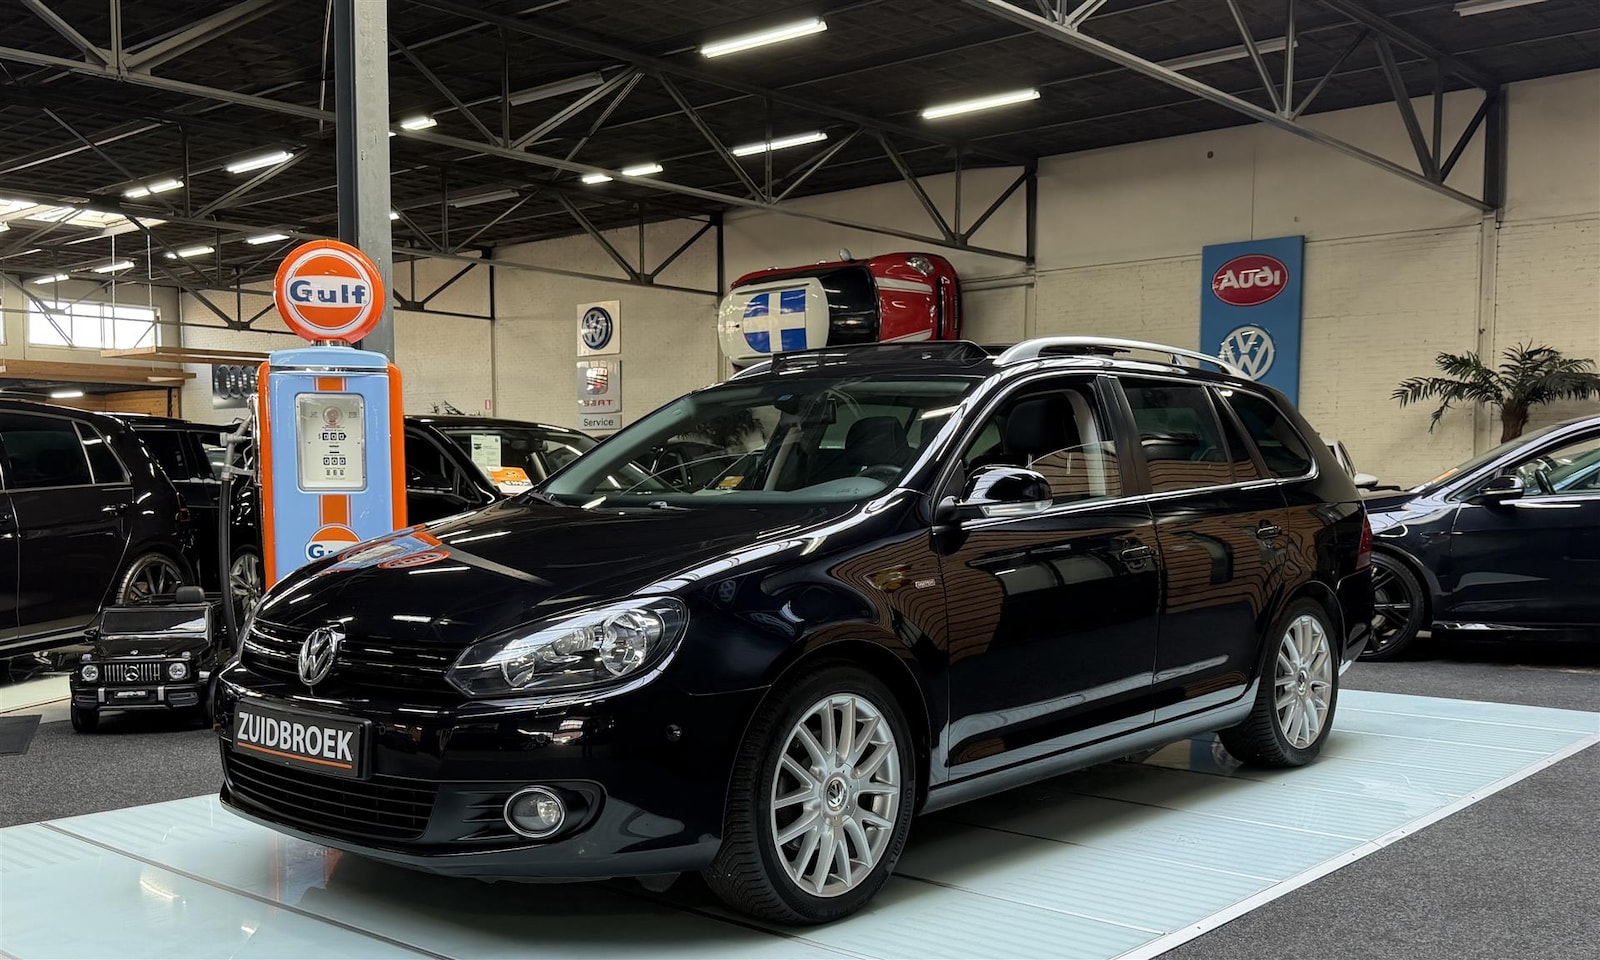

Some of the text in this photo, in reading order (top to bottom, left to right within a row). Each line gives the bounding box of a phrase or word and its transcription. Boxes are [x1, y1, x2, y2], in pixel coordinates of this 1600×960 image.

[290, 280, 366, 304] Gulf
[583, 418, 614, 427] Service
[237, 711, 353, 762] ZUIDBROEK
